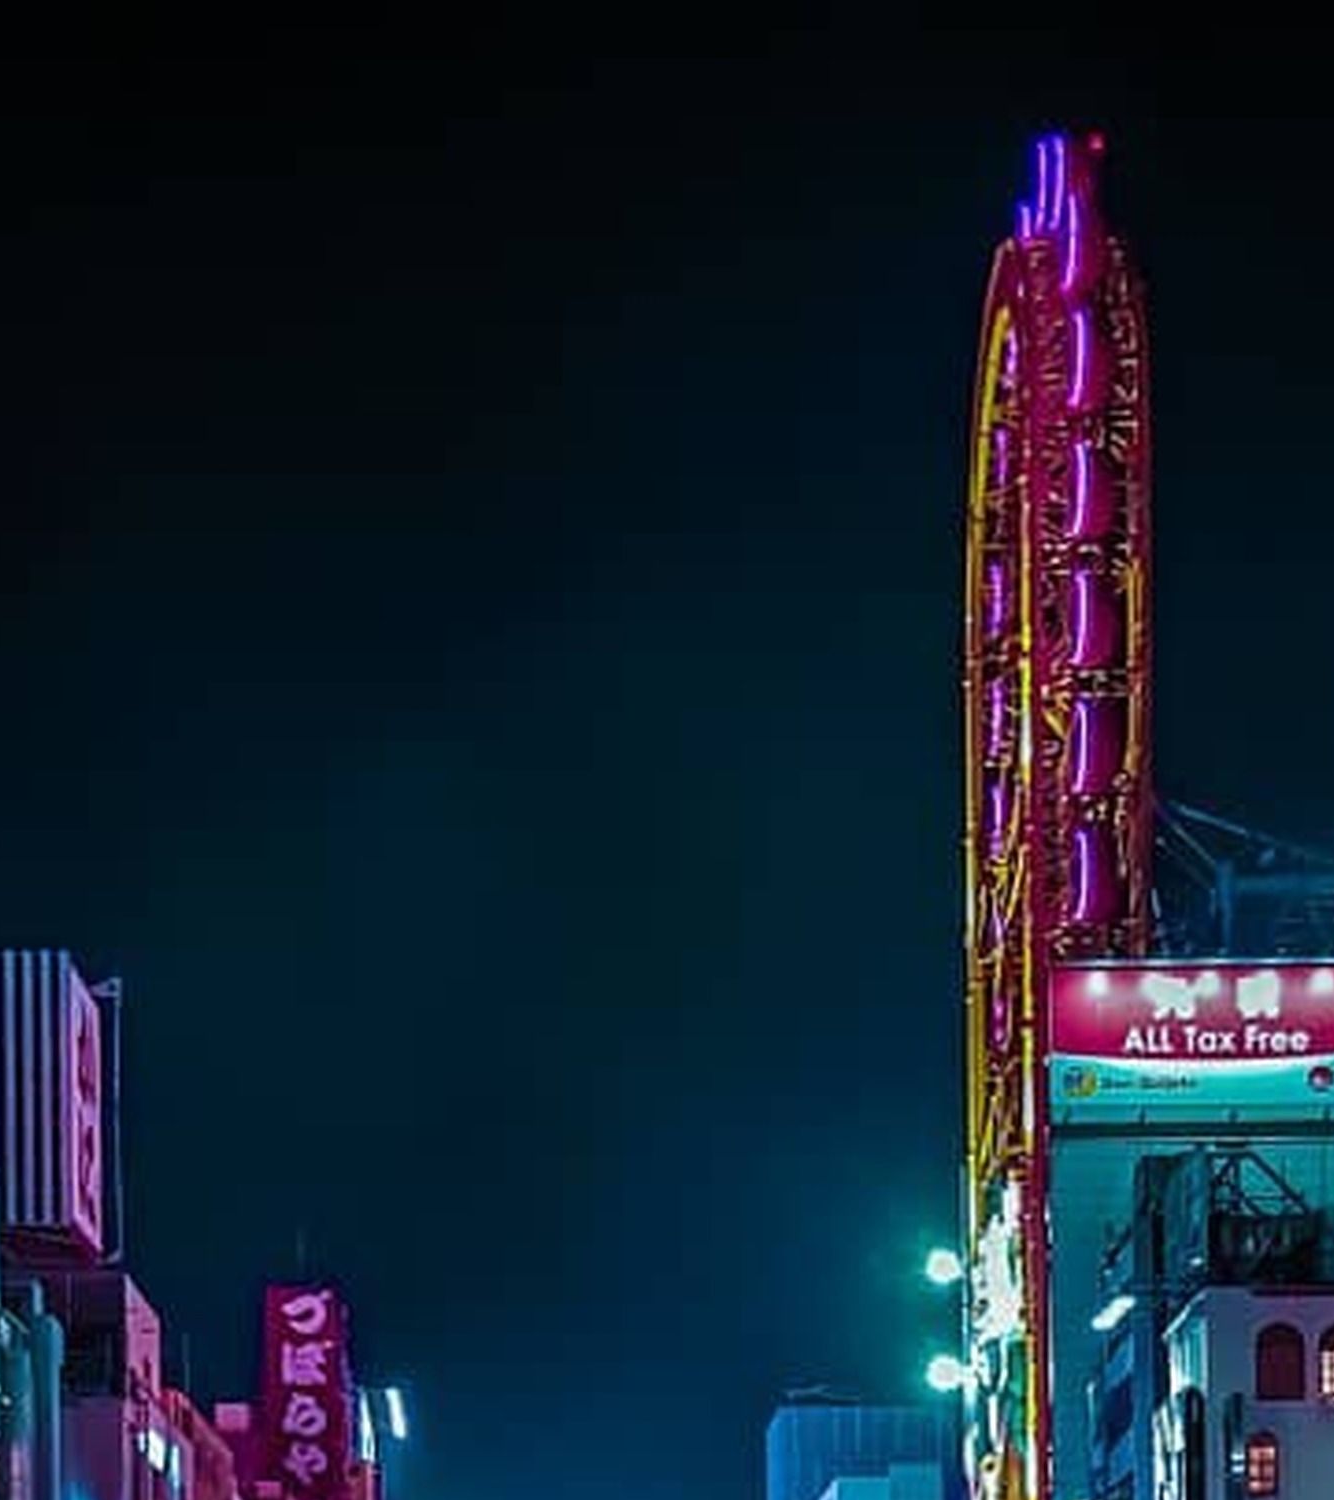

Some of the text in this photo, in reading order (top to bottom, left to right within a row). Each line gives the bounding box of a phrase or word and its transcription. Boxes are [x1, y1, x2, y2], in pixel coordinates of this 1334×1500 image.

[1124, 1025, 1310, 1053] ALL Tax Free
